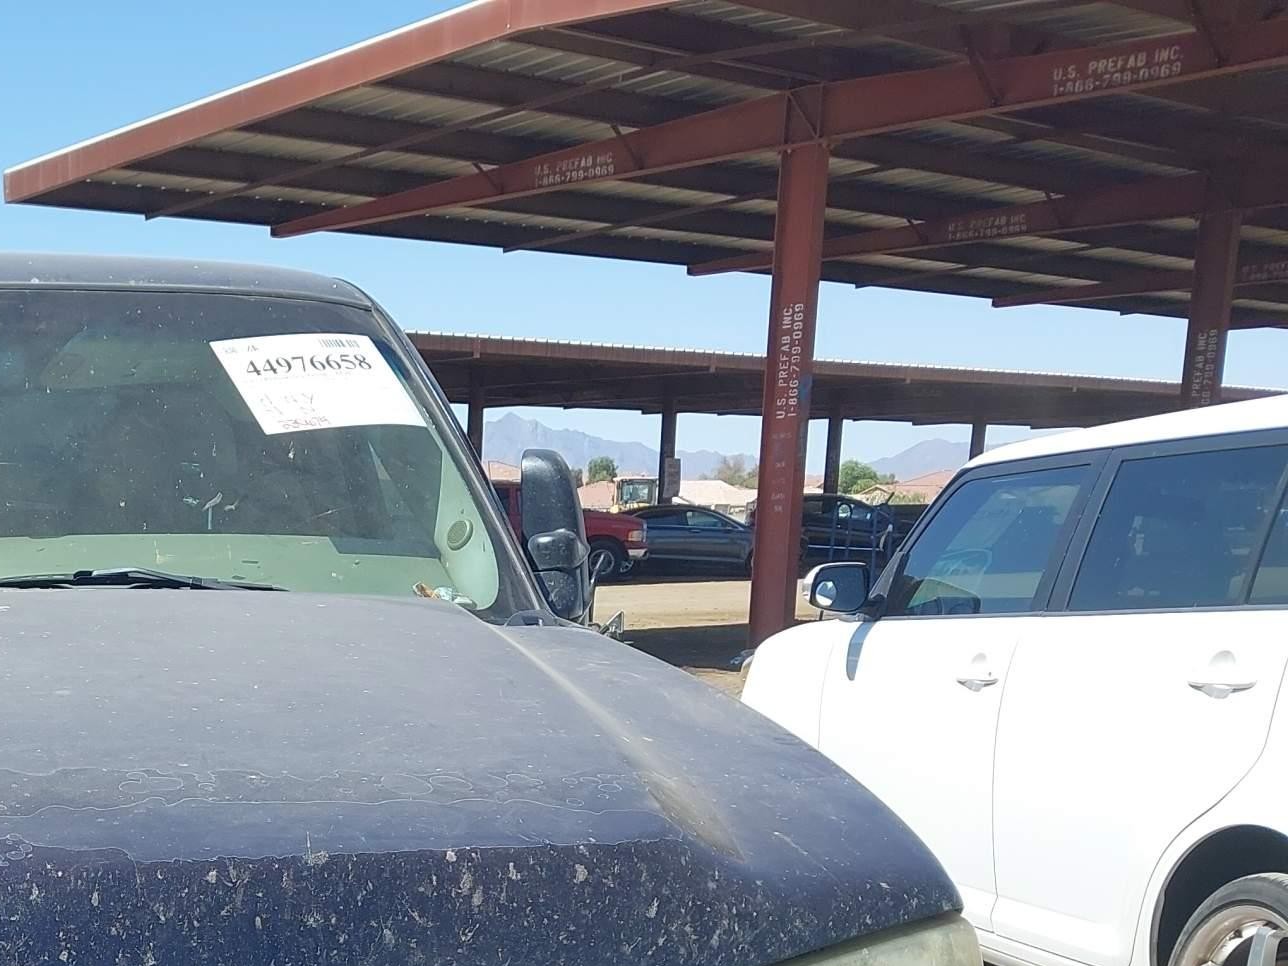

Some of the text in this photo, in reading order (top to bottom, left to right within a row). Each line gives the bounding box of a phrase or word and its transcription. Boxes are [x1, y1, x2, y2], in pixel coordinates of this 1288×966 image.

[1053, 45, 1184, 80] U.S. PREFAB INC.
[1052, 61, 1182, 96] 1-866-799-0969
[535, 163, 615, 188] 1-866-799-0969
[555, 155, 593, 172] PREFAB
[782, 303, 793, 329] INC.
[245, 353, 372, 376] 44976658
[778, 335, 791, 387] PREFAB
[787, 303, 804, 417] 1-866-799-0969
[1192, 355, 1205, 397] PREFAB
[776, 393, 788, 419] U.S.
